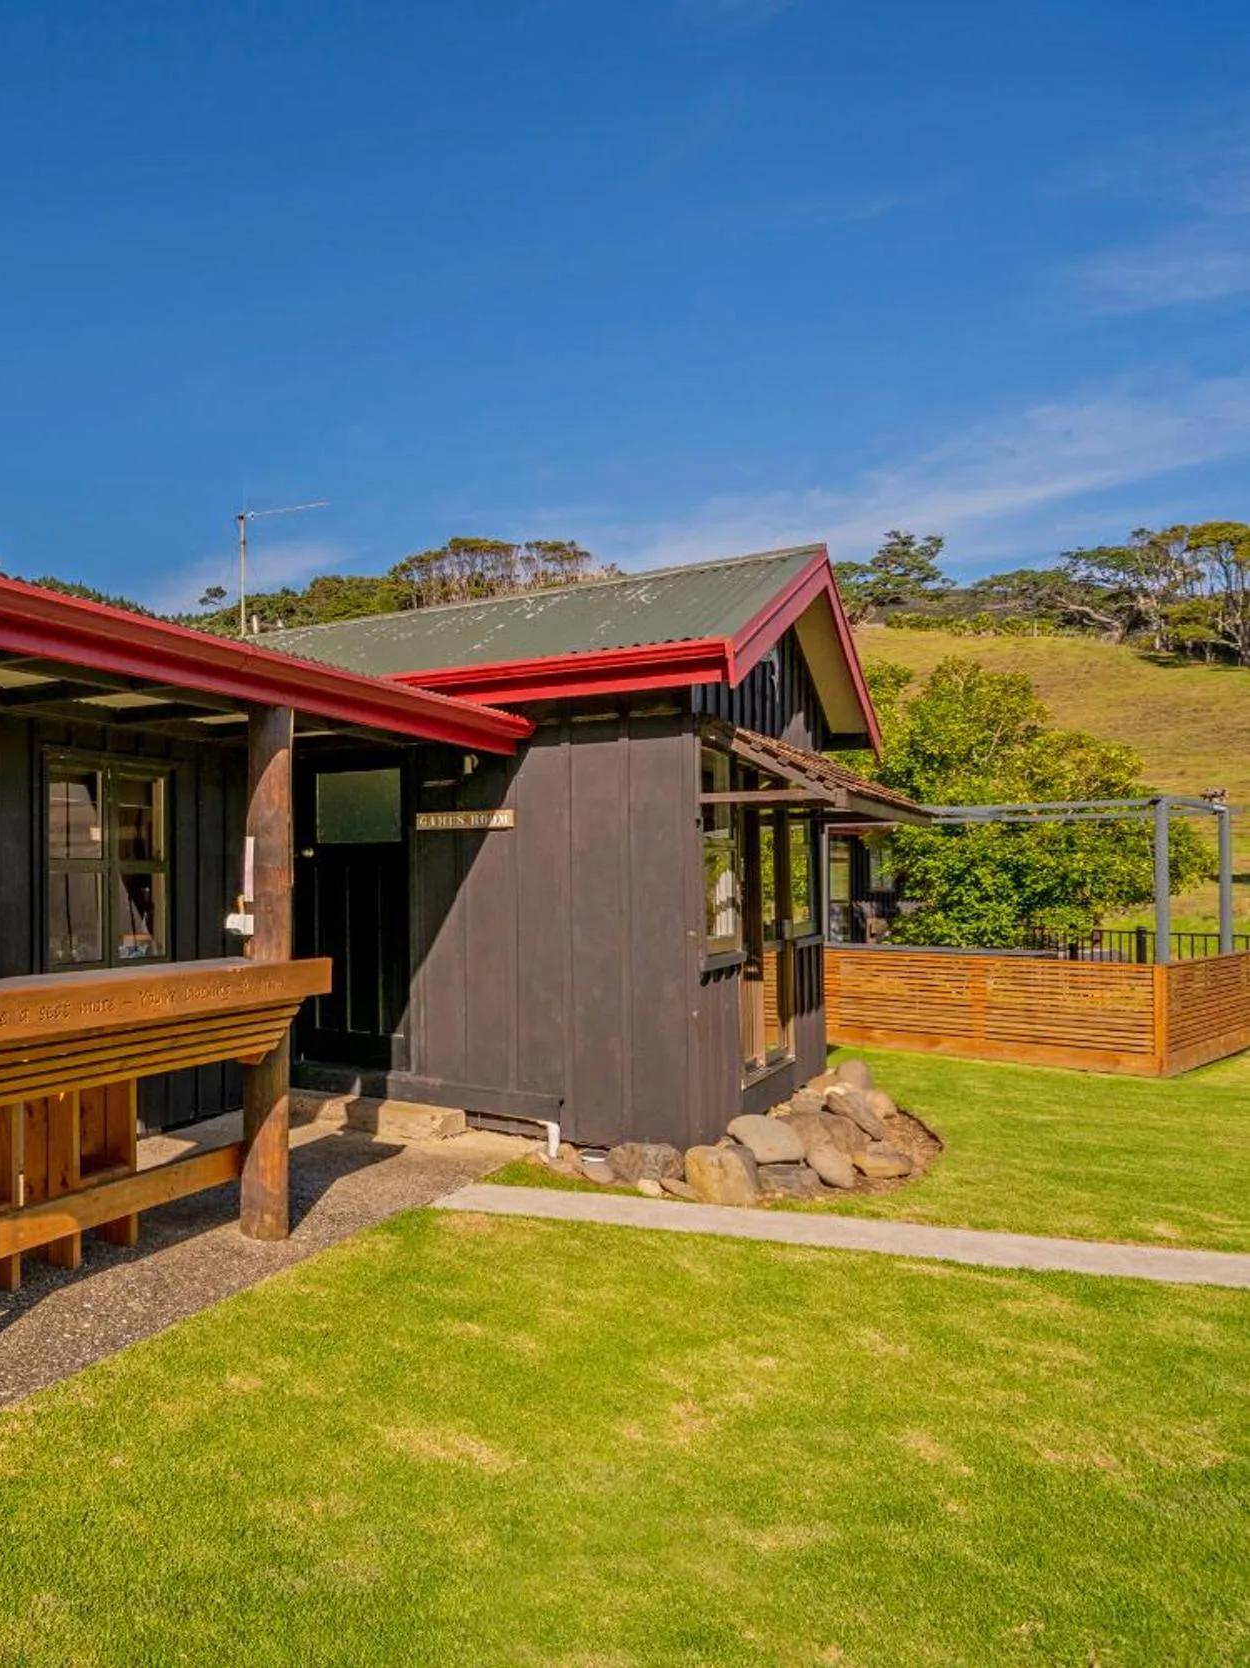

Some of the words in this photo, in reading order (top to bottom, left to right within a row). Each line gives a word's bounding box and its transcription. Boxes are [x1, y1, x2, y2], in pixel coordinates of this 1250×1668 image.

[418, 815, 465, 828] GAMES
[470, 813, 510, 826] ROOM
[20, 1008, 31, 1023] a
